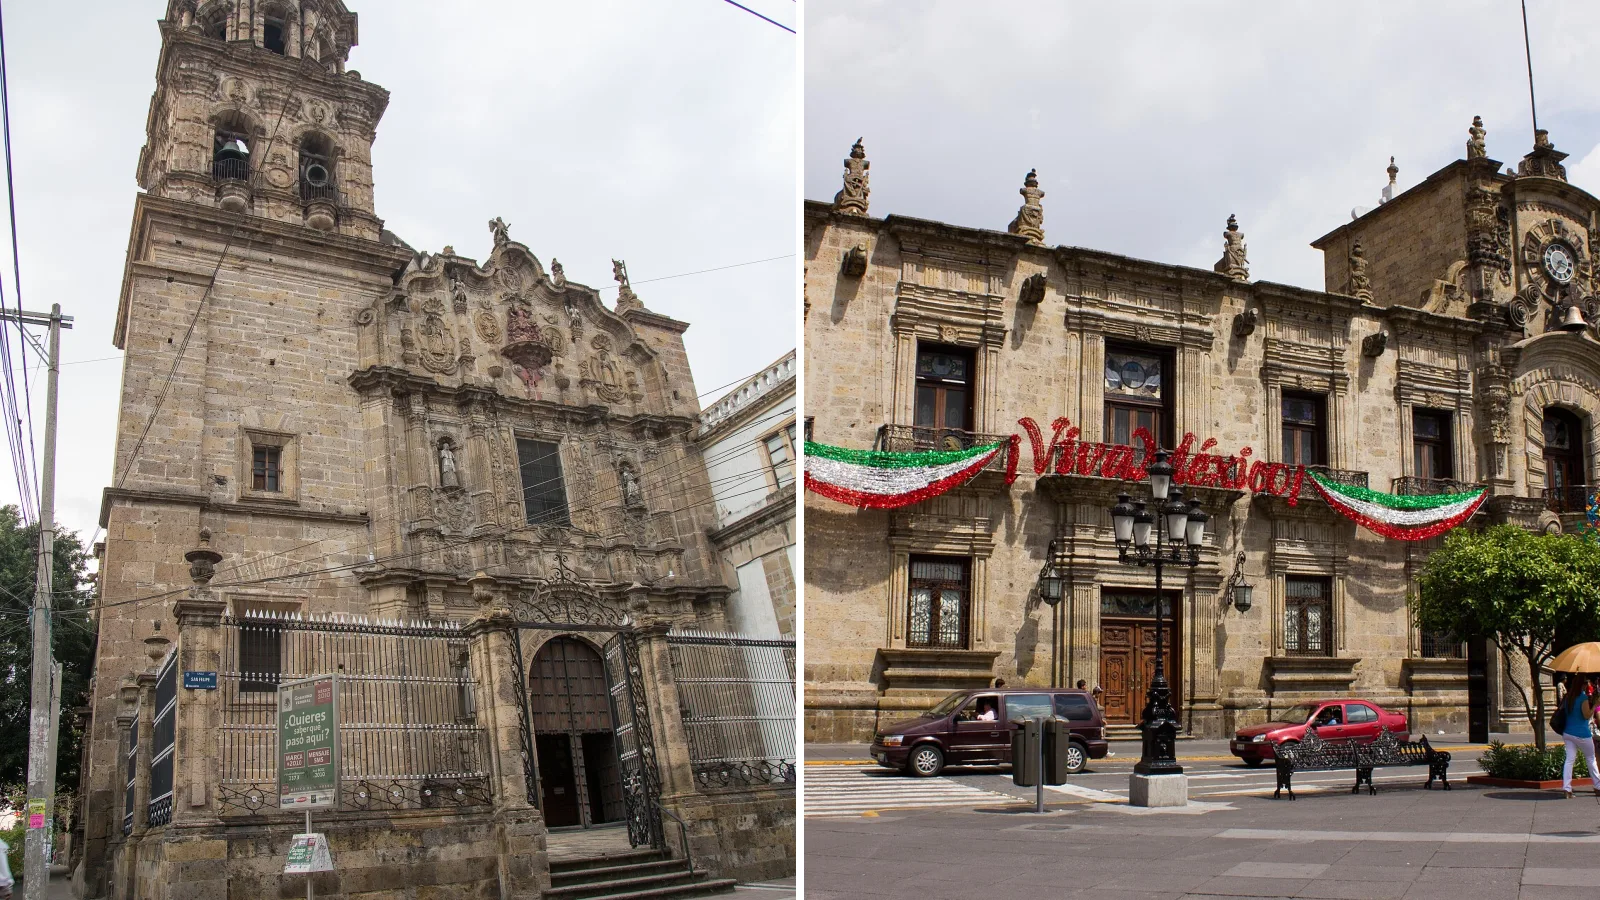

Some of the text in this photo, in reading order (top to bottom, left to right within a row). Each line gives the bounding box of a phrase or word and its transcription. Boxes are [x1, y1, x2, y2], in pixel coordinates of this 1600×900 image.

[284, 711, 326, 729] ¿Quieres
[293, 722, 321, 735] saber qué
[285, 728, 330, 750] pasó aquí?
